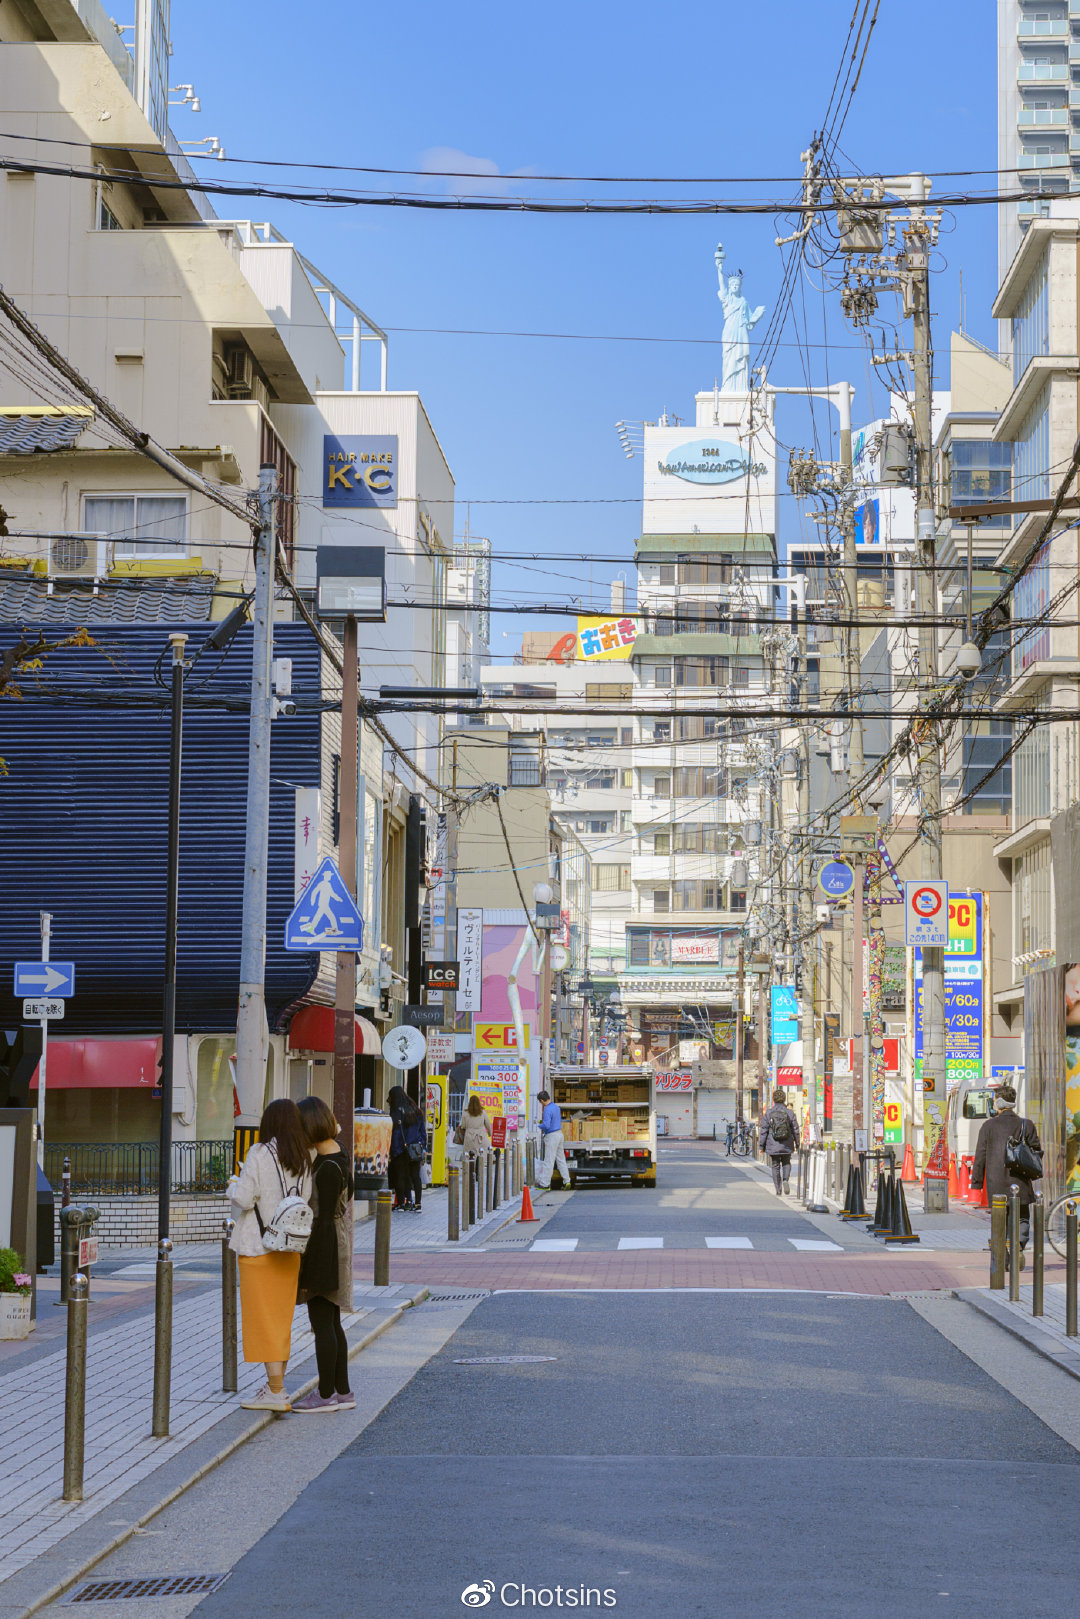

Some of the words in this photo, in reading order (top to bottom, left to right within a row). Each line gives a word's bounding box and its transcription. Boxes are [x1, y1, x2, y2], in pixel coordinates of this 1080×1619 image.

[328, 452, 356, 462] HAIR
[360, 452, 393, 463] MAKE
[428, 964, 455, 980] ice
[410, 1010, 440, 1021] Aesop
